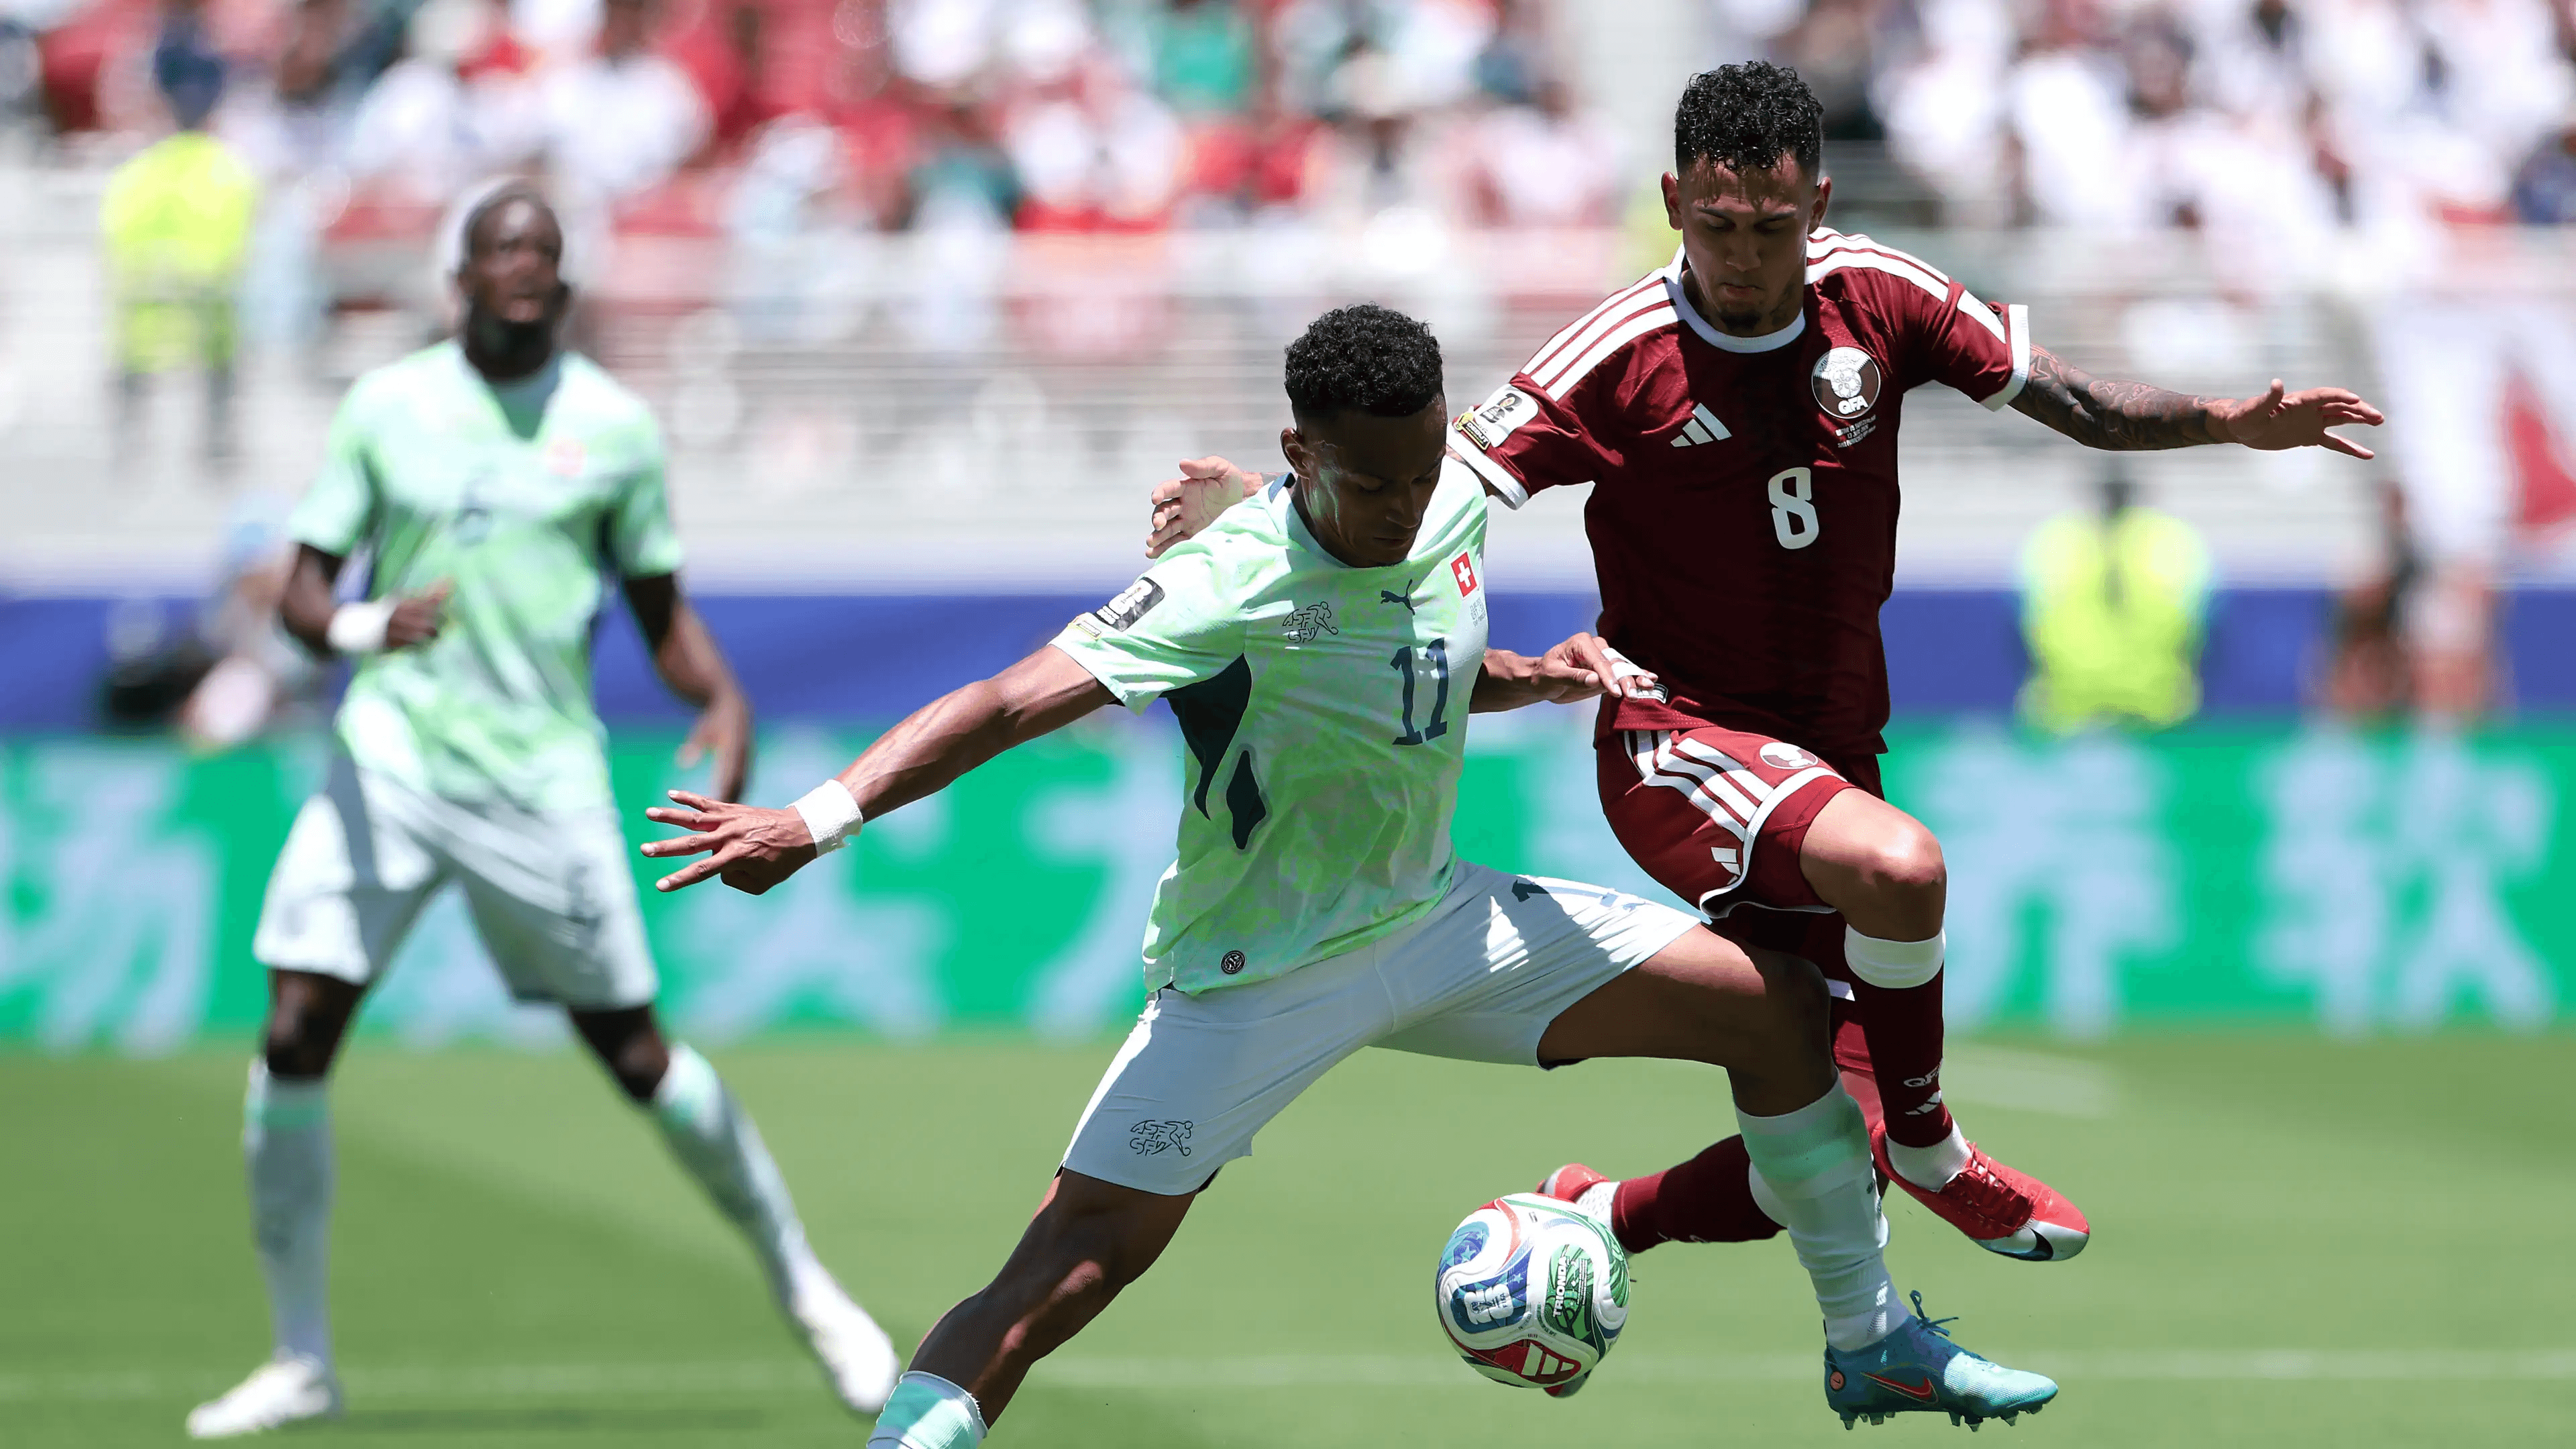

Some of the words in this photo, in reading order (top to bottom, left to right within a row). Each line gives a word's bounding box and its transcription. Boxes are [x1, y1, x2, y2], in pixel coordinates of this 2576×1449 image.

[1466, 421, 1489, 443] DEBUT
[1838, 395, 1869, 415] QFA
[1768, 467, 1819, 549] 8
[1390, 637, 1449, 746] 11
[1553, 1256, 1570, 1318] TRIONDA
